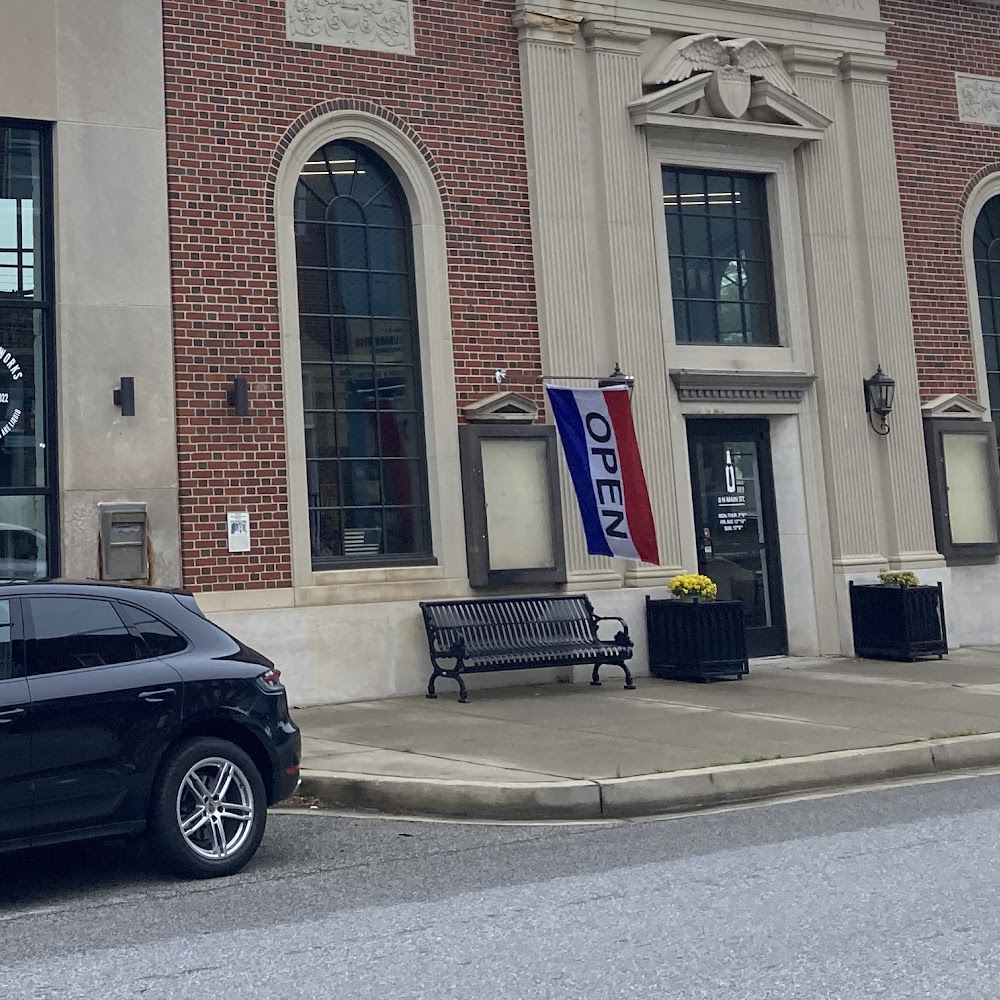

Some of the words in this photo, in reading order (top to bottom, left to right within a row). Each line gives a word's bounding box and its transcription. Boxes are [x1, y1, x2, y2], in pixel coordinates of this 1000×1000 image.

[1, 424, 11, 436] ARE
[7, 408, 22, 427] LIQUID
[585, 411, 629, 539] OPEN
